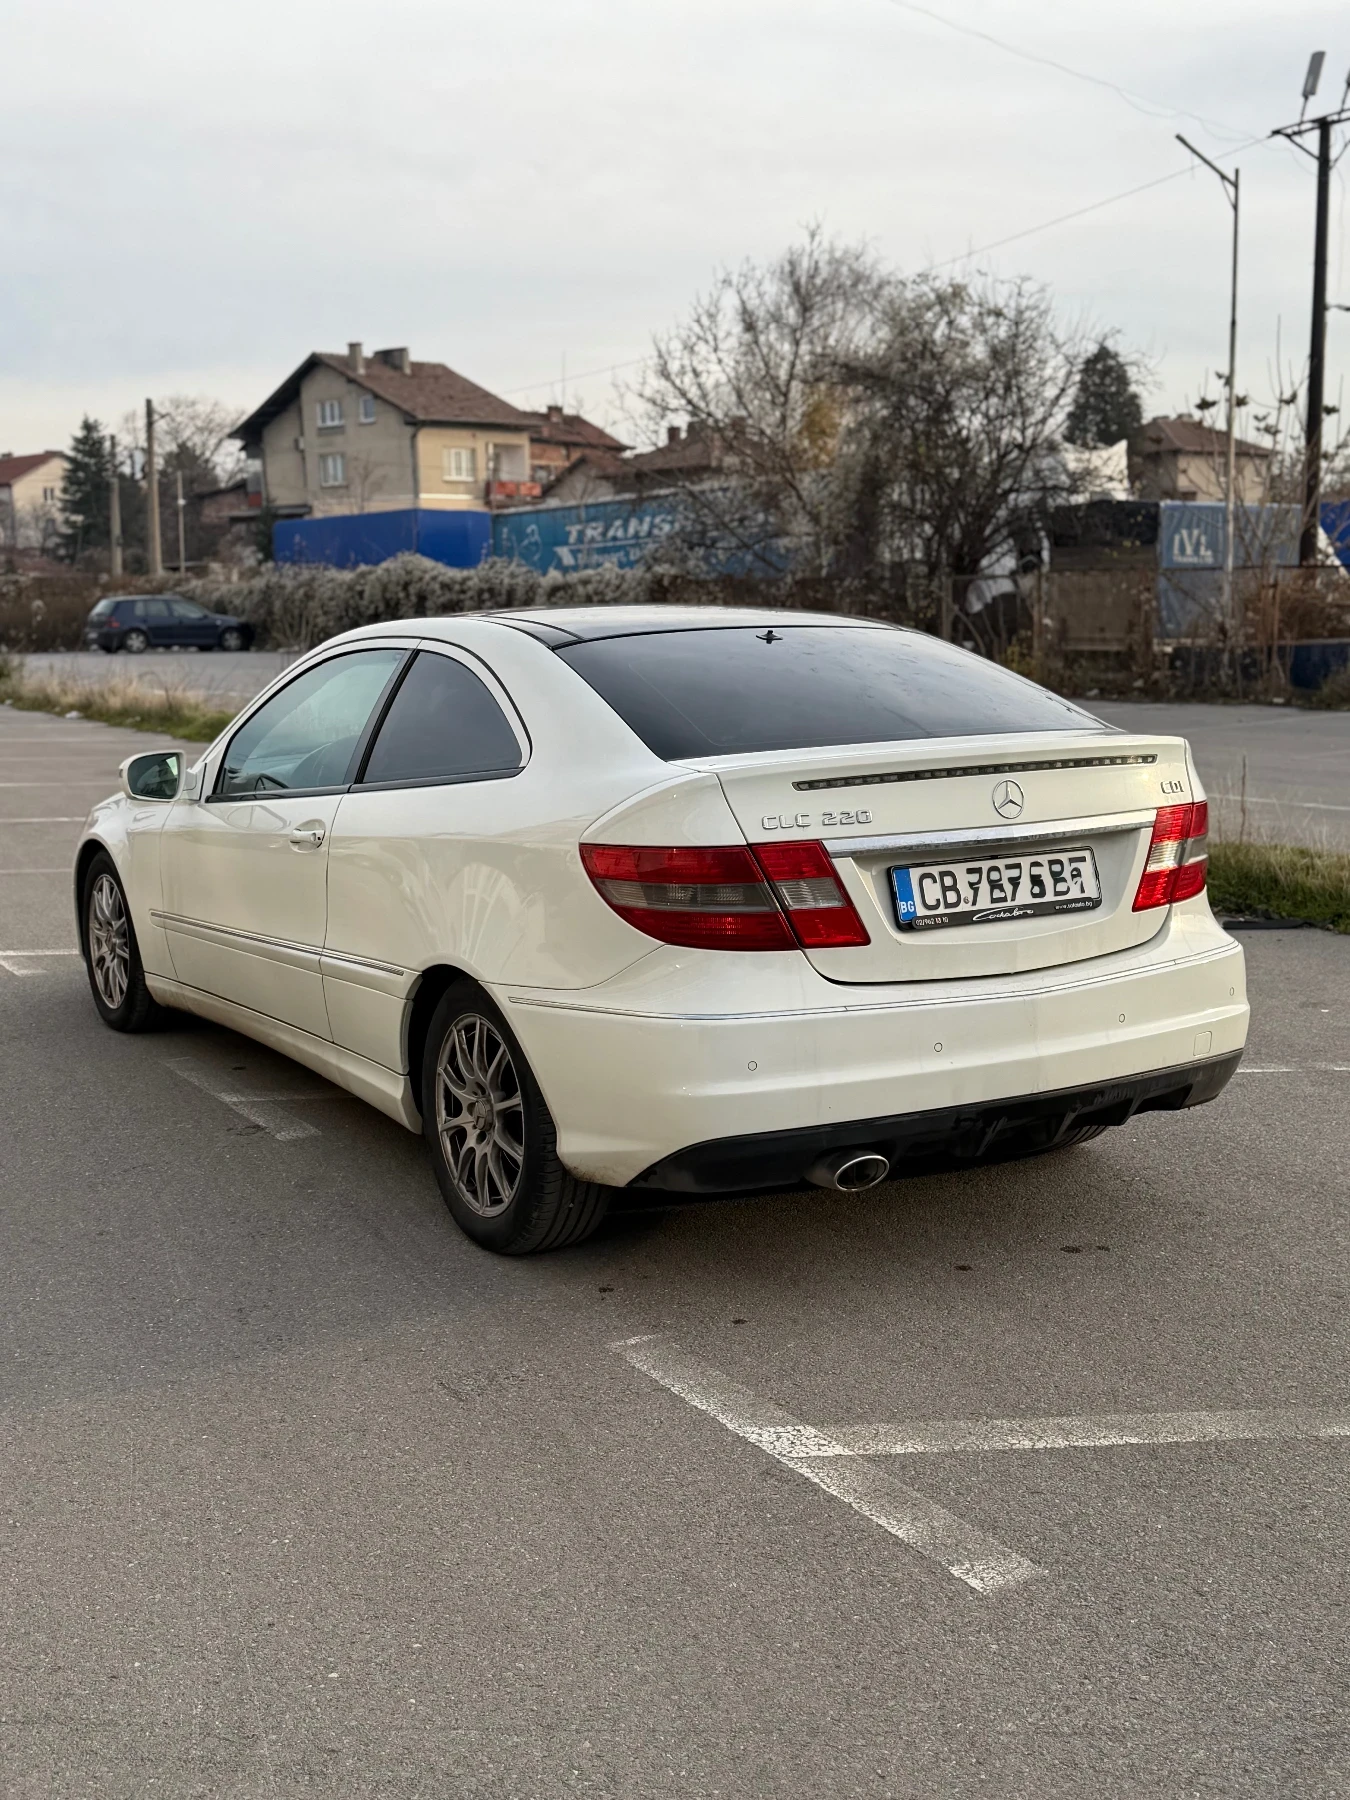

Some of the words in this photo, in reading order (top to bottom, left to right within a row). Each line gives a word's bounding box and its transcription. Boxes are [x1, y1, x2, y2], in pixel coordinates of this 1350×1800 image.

[1160, 780, 1185, 795] CDI
[762, 813, 811, 830] CLC
[822, 809, 873, 826] 220
[901, 901, 915, 913] BG
